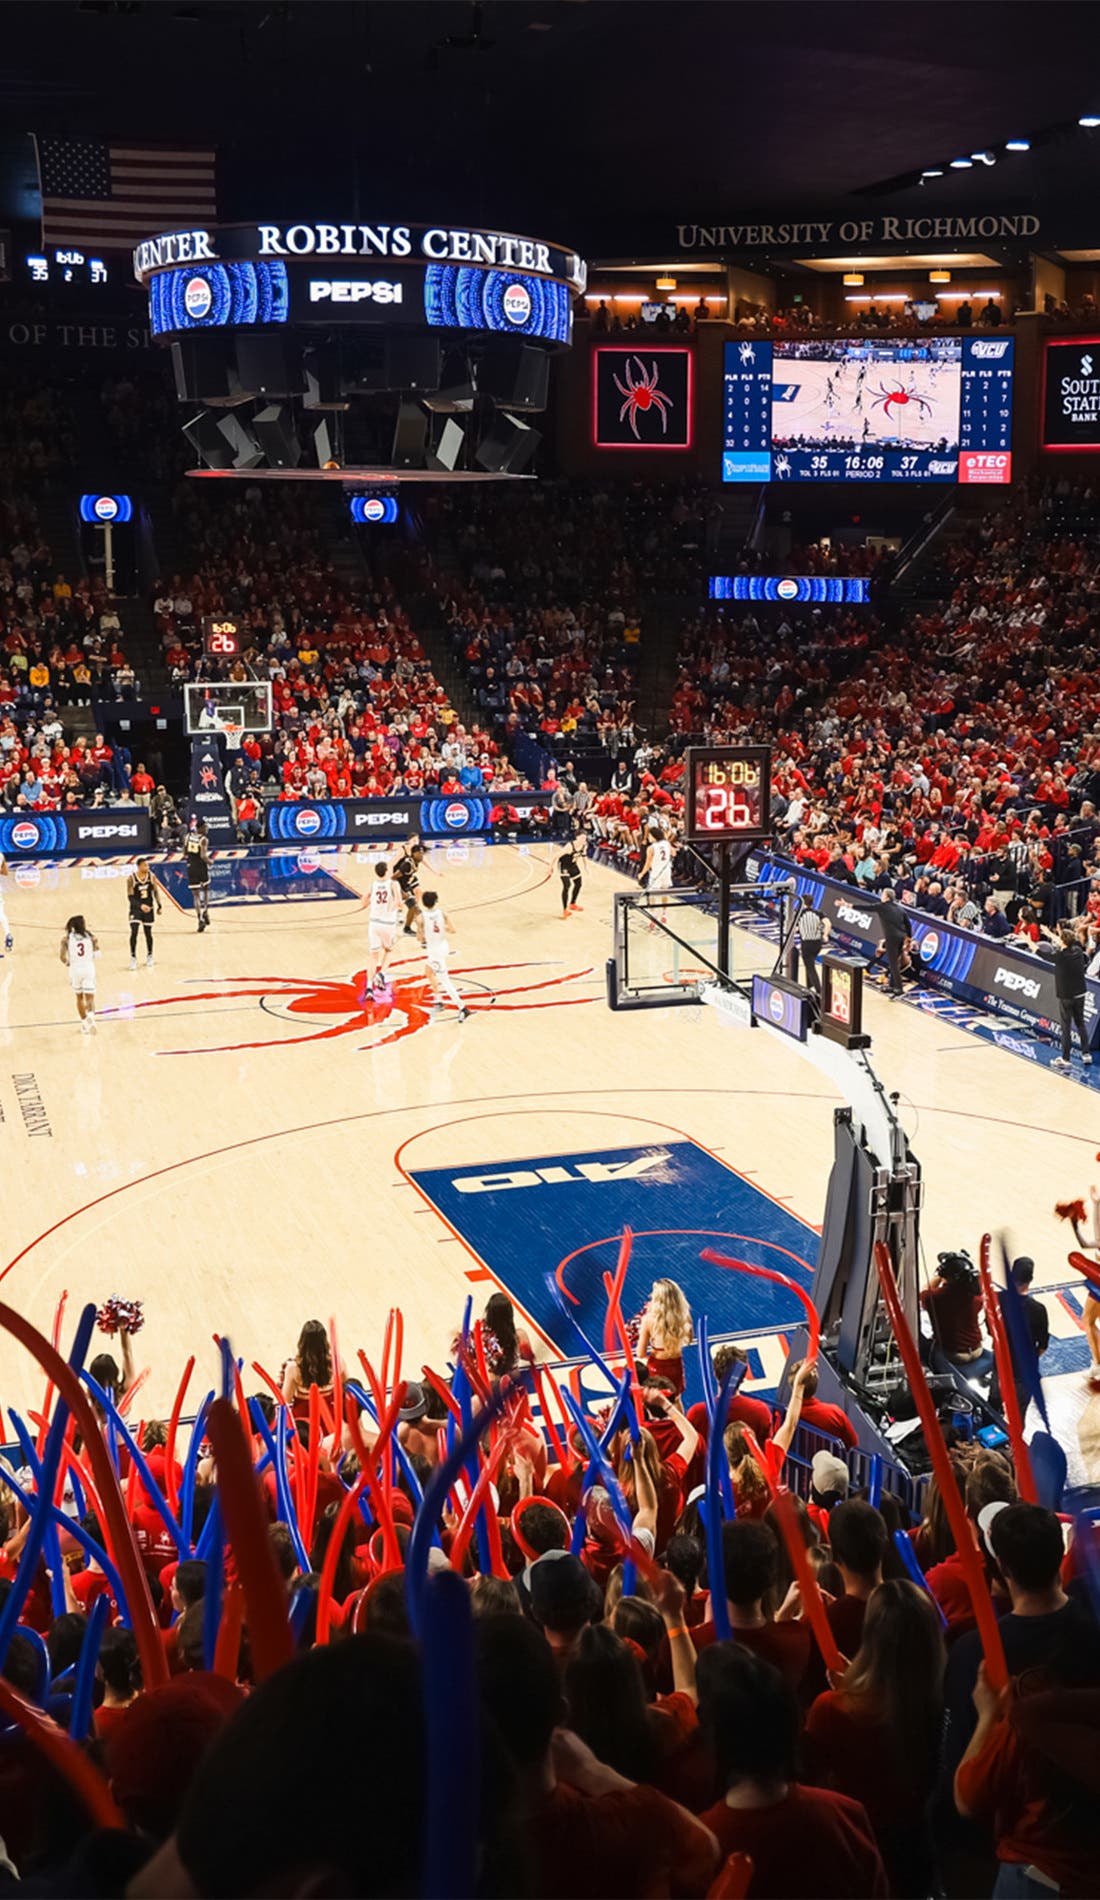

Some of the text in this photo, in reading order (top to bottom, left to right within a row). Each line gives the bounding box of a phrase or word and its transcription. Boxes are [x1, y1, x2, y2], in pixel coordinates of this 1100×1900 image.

[677, 215, 1041, 248] UNIVERSITY OF RICHMOND
[258, 224, 553, 274] ROBINS CENTER
[309, 281, 403, 304] PEPSI
[9, 323, 47, 345] OF
[56, 325, 118, 348] THE
[1061, 377, 1100, 395] SOUT
[1062, 396, 1100, 415] STAT
[1071, 412, 1098, 422] BANK
[810, 455, 828, 469] 35
[844, 455, 884, 470] 16:06
[900, 456, 919, 469] 37
[966, 455, 1008, 468] eTEC
[844, 470, 881, 479] PERIOD 2
[211, 633, 235, 652] 26
[705, 788, 750, 829] 26
[355, 812, 409, 826] PEPSI
[78, 824, 138, 839] PEPSI
[660, 850, 666, 860] 2
[376, 890, 388, 904] 32
[836, 906, 873, 931] PEPSI
[77, 942, 85, 957] 3
[993, 967, 1042, 999] PEPSI
